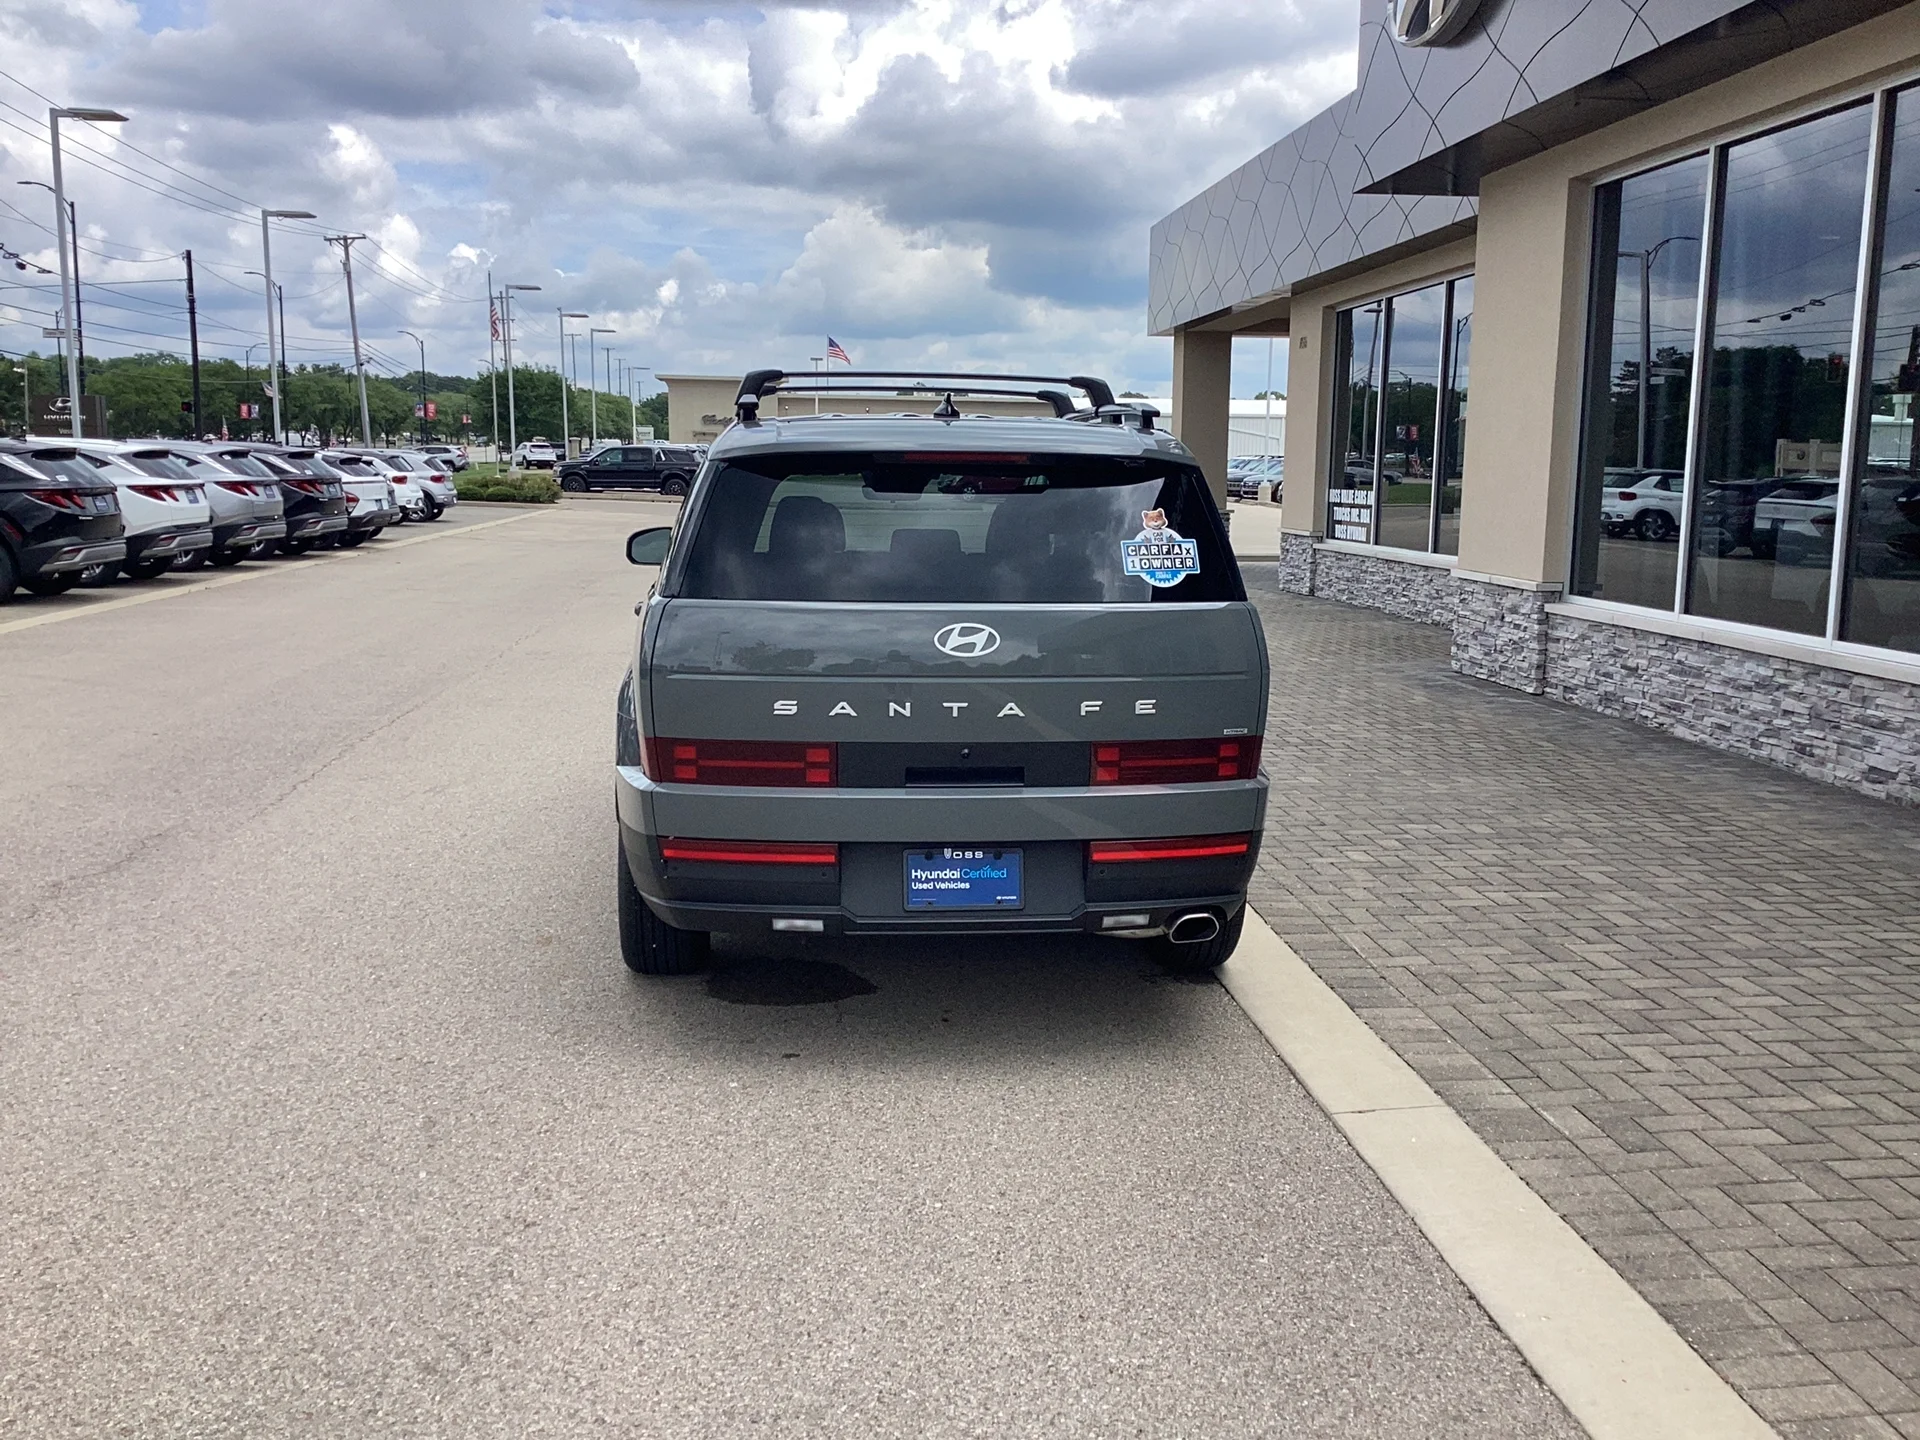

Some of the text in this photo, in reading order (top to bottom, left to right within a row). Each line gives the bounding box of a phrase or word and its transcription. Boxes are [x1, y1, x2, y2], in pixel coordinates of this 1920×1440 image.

[1127, 544, 1192, 556] CARFAX
[1130, 558, 1194, 569] 1 OWNER
[773, 700, 1156, 717] SANTA FE
[911, 865, 1007, 881] Hyundai Certified
[935, 881, 970, 889] Vehicles
